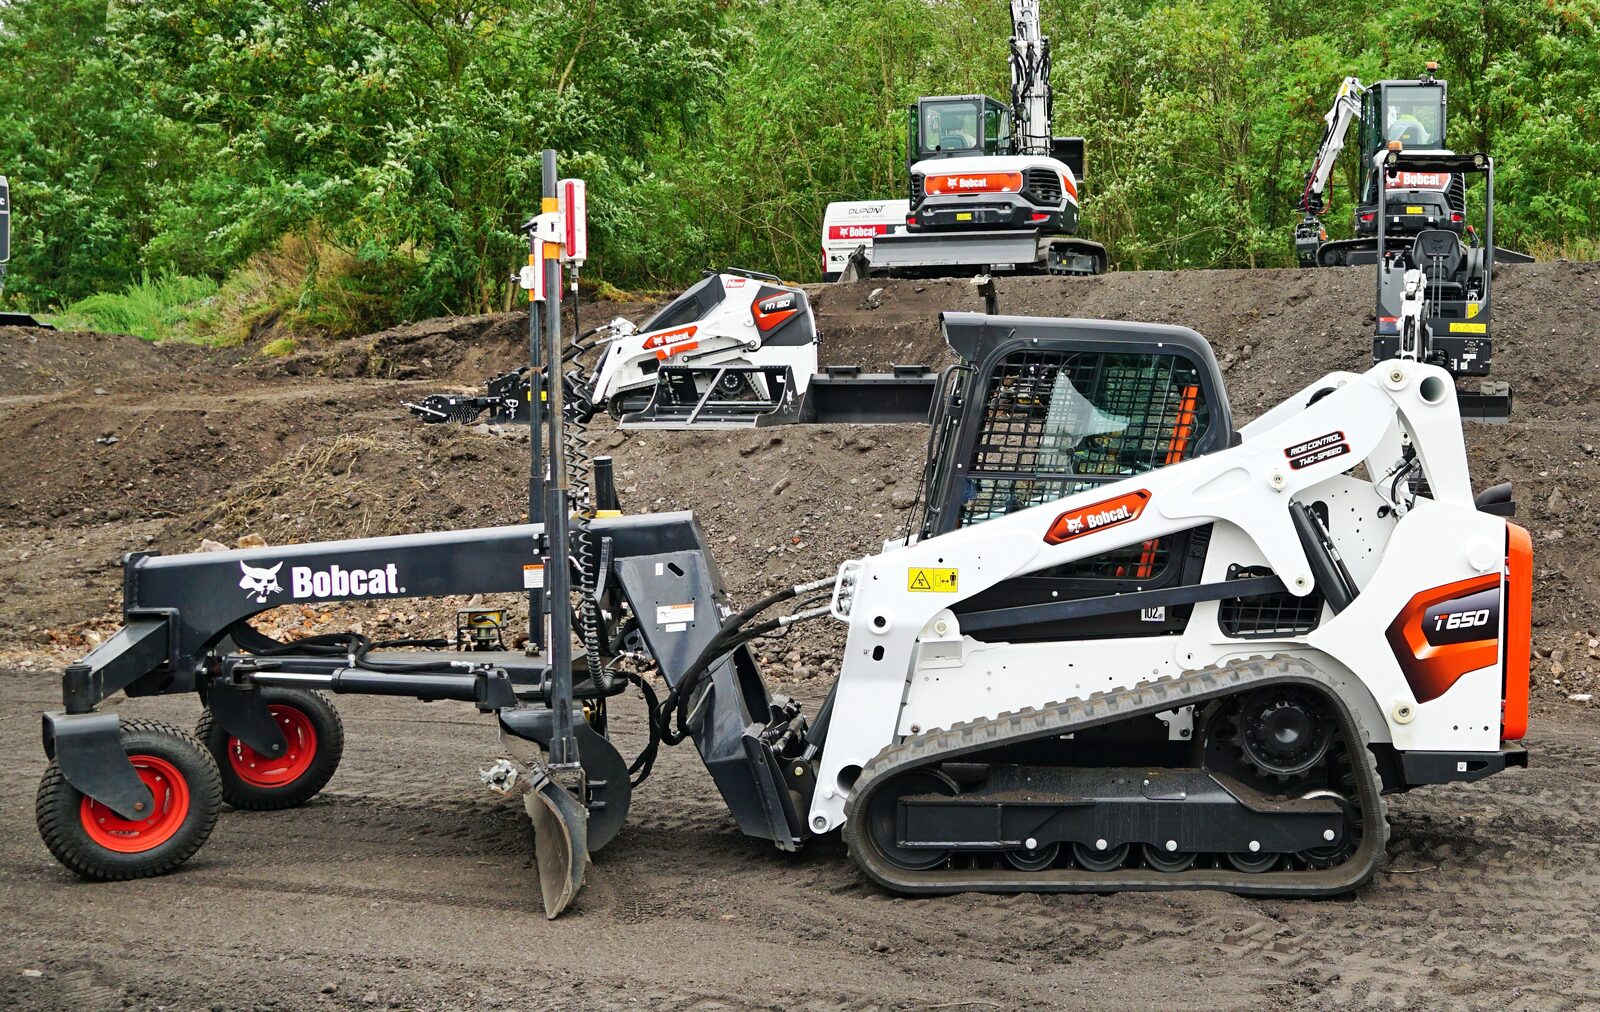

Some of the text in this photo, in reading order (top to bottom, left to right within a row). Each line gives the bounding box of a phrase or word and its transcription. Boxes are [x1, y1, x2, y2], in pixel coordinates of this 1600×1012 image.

[959, 177, 987, 188] Bobcat
[1403, 172, 1439, 185] Bobcat
[848, 205, 886, 215] DUPONT
[849, 227, 877, 237] Bobcat
[665, 331, 689, 344] Bobcat
[1290, 433, 1342, 456] RIDE CONTROL
[1299, 446, 1342, 466] TWO-SPEED
[1086, 504, 1130, 529] Bobcat
[291, 563, 399, 598] Bobcat
[1144, 607, 1158, 619] 102
[1433, 609, 1490, 632] T650
